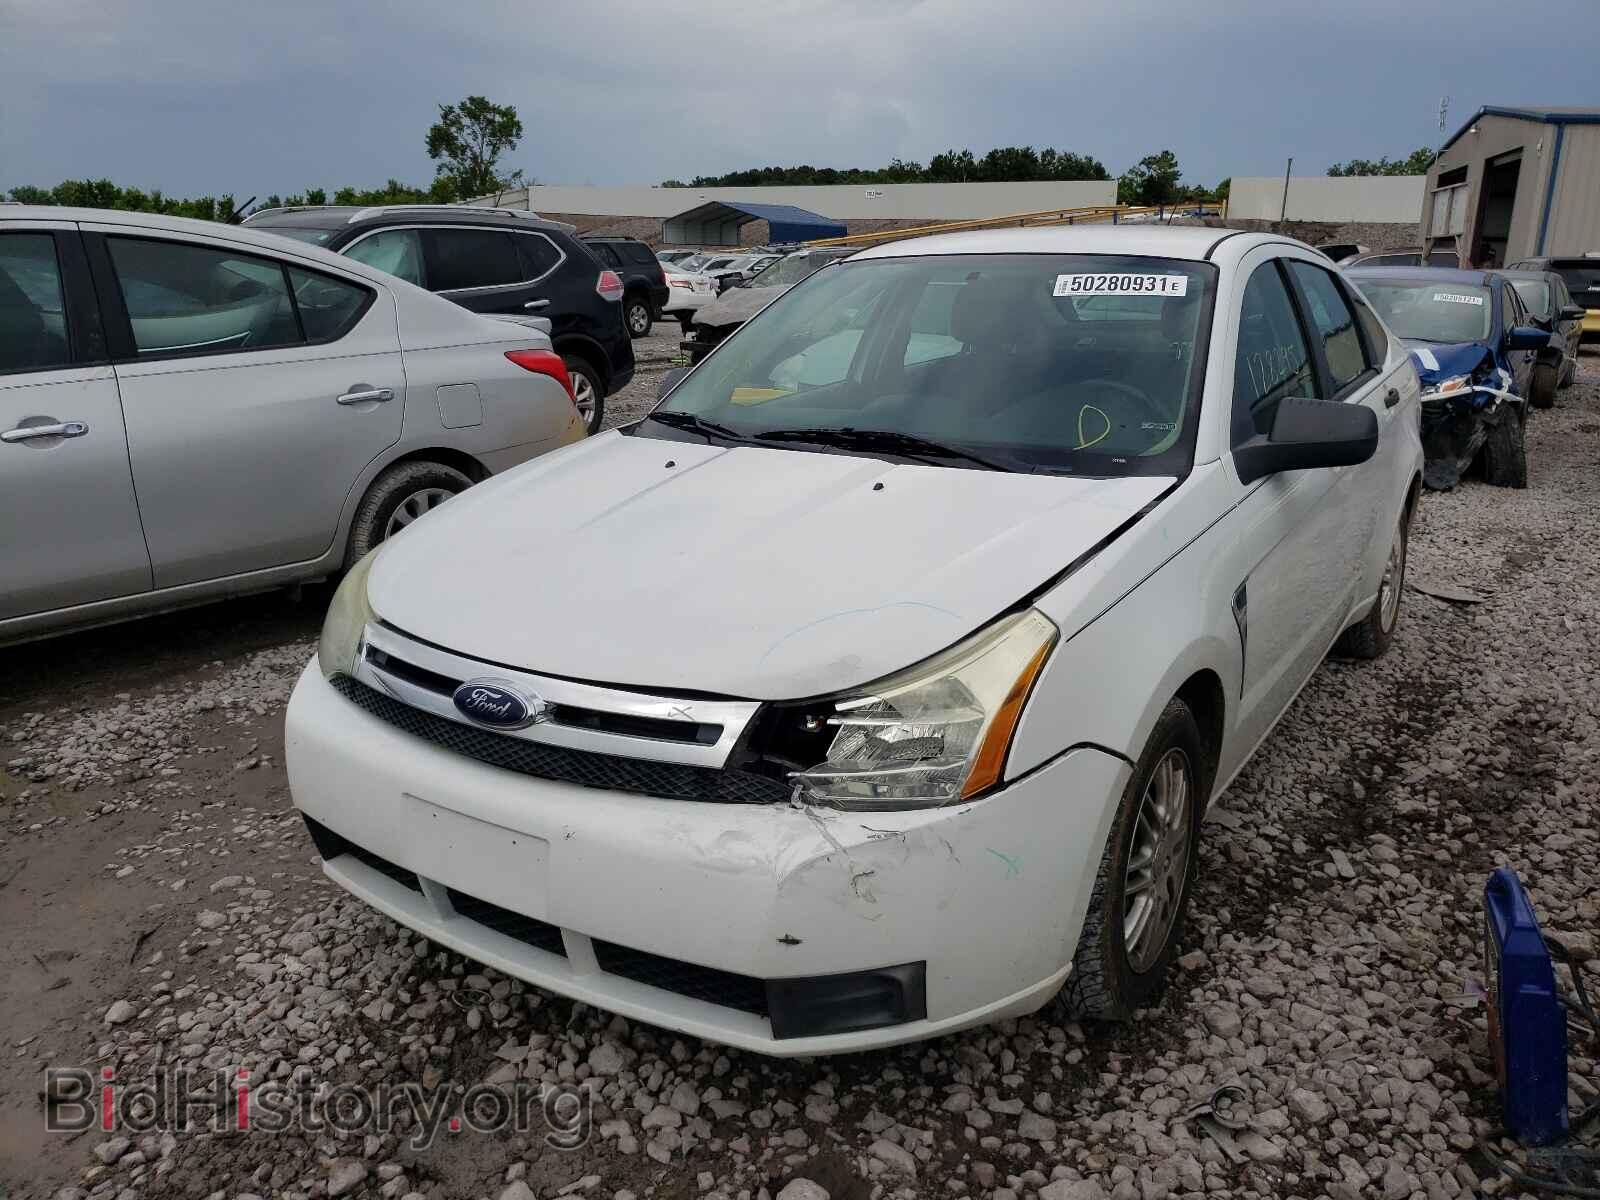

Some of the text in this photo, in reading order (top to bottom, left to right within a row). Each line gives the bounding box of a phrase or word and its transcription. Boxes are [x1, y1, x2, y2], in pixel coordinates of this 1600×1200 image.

[1070, 275, 1167, 292] 50280931
[1172, 282, 1179, 291] E
[466, 688, 512, 718] Ford
